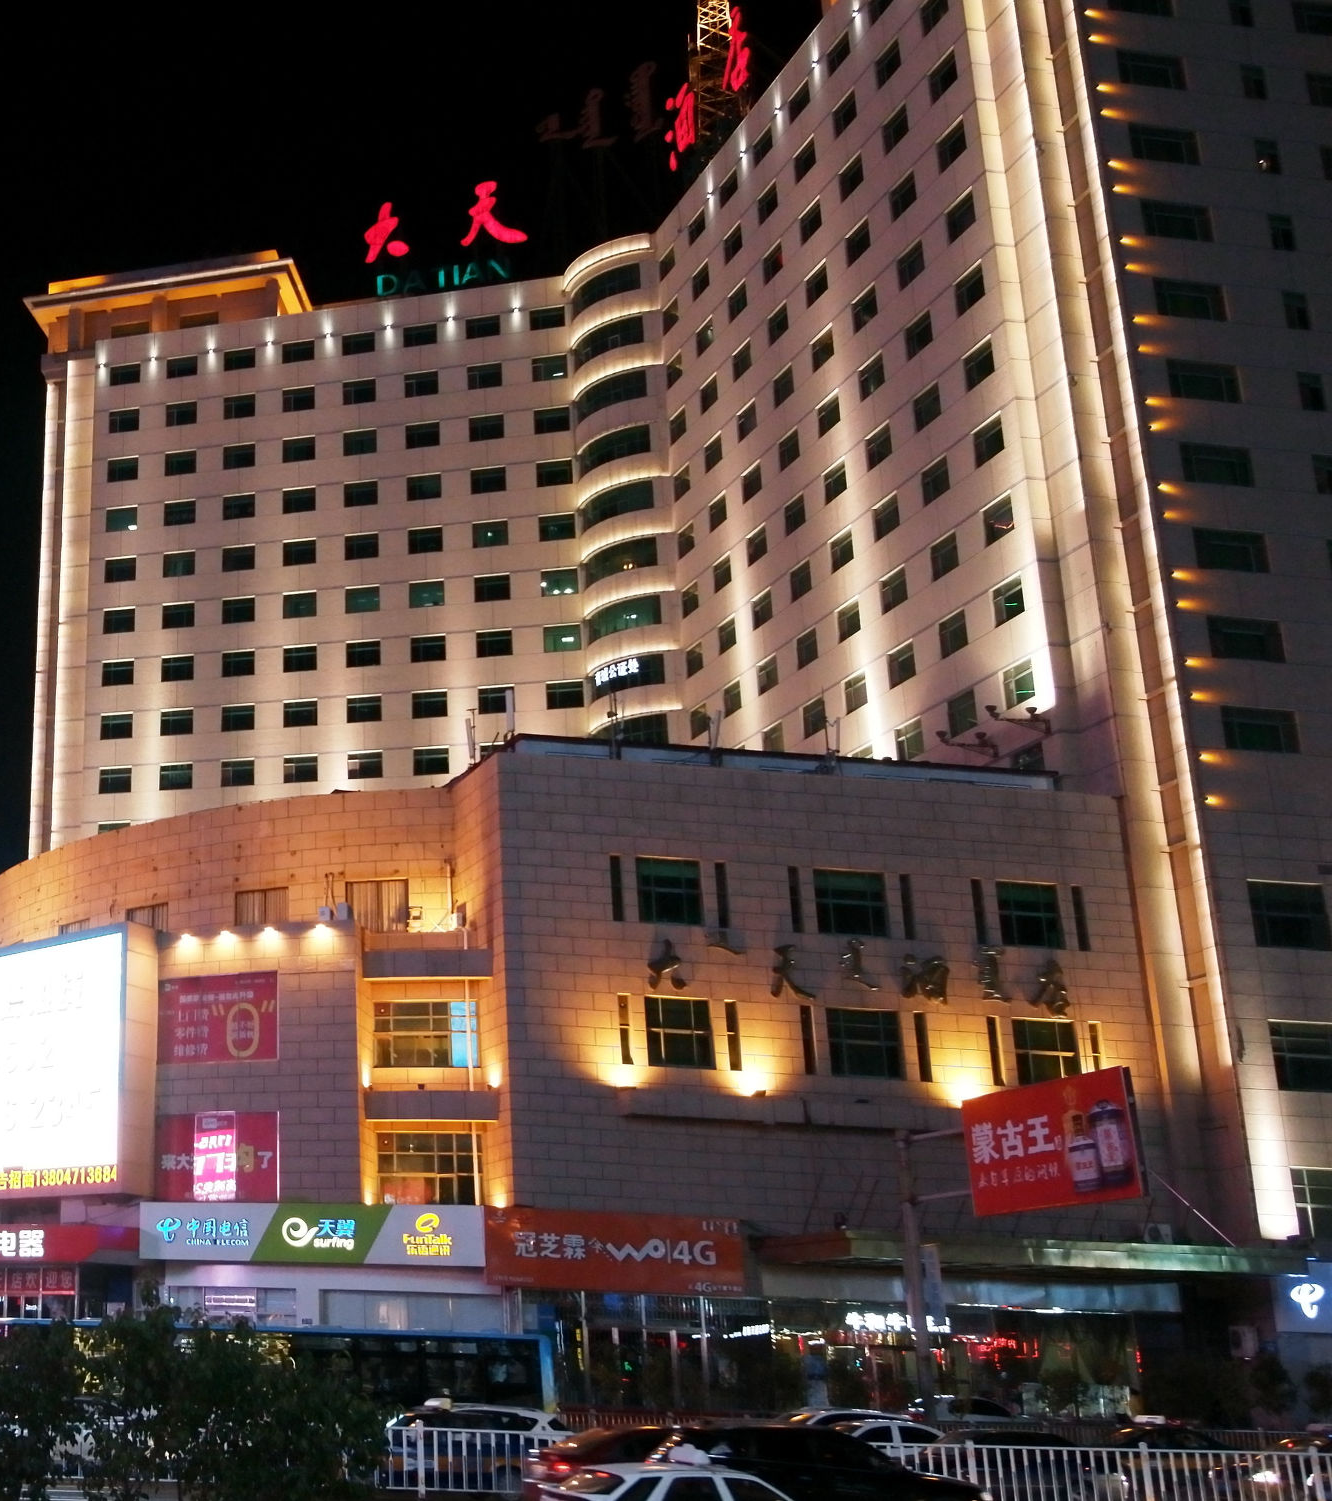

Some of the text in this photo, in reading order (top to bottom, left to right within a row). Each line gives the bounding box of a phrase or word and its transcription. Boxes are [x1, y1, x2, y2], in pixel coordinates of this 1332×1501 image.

[971, 1114, 1056, 1165] 蒙古王
[186, 1217, 250, 1238] 中国电信
[317, 1219, 357, 1238] 天翼
[186, 1238, 211, 1246] CHINA
[313, 1237, 355, 1250] surfing
[402, 1234, 452, 1246] FunTalk
[672, 1240, 717, 1266] 4G
